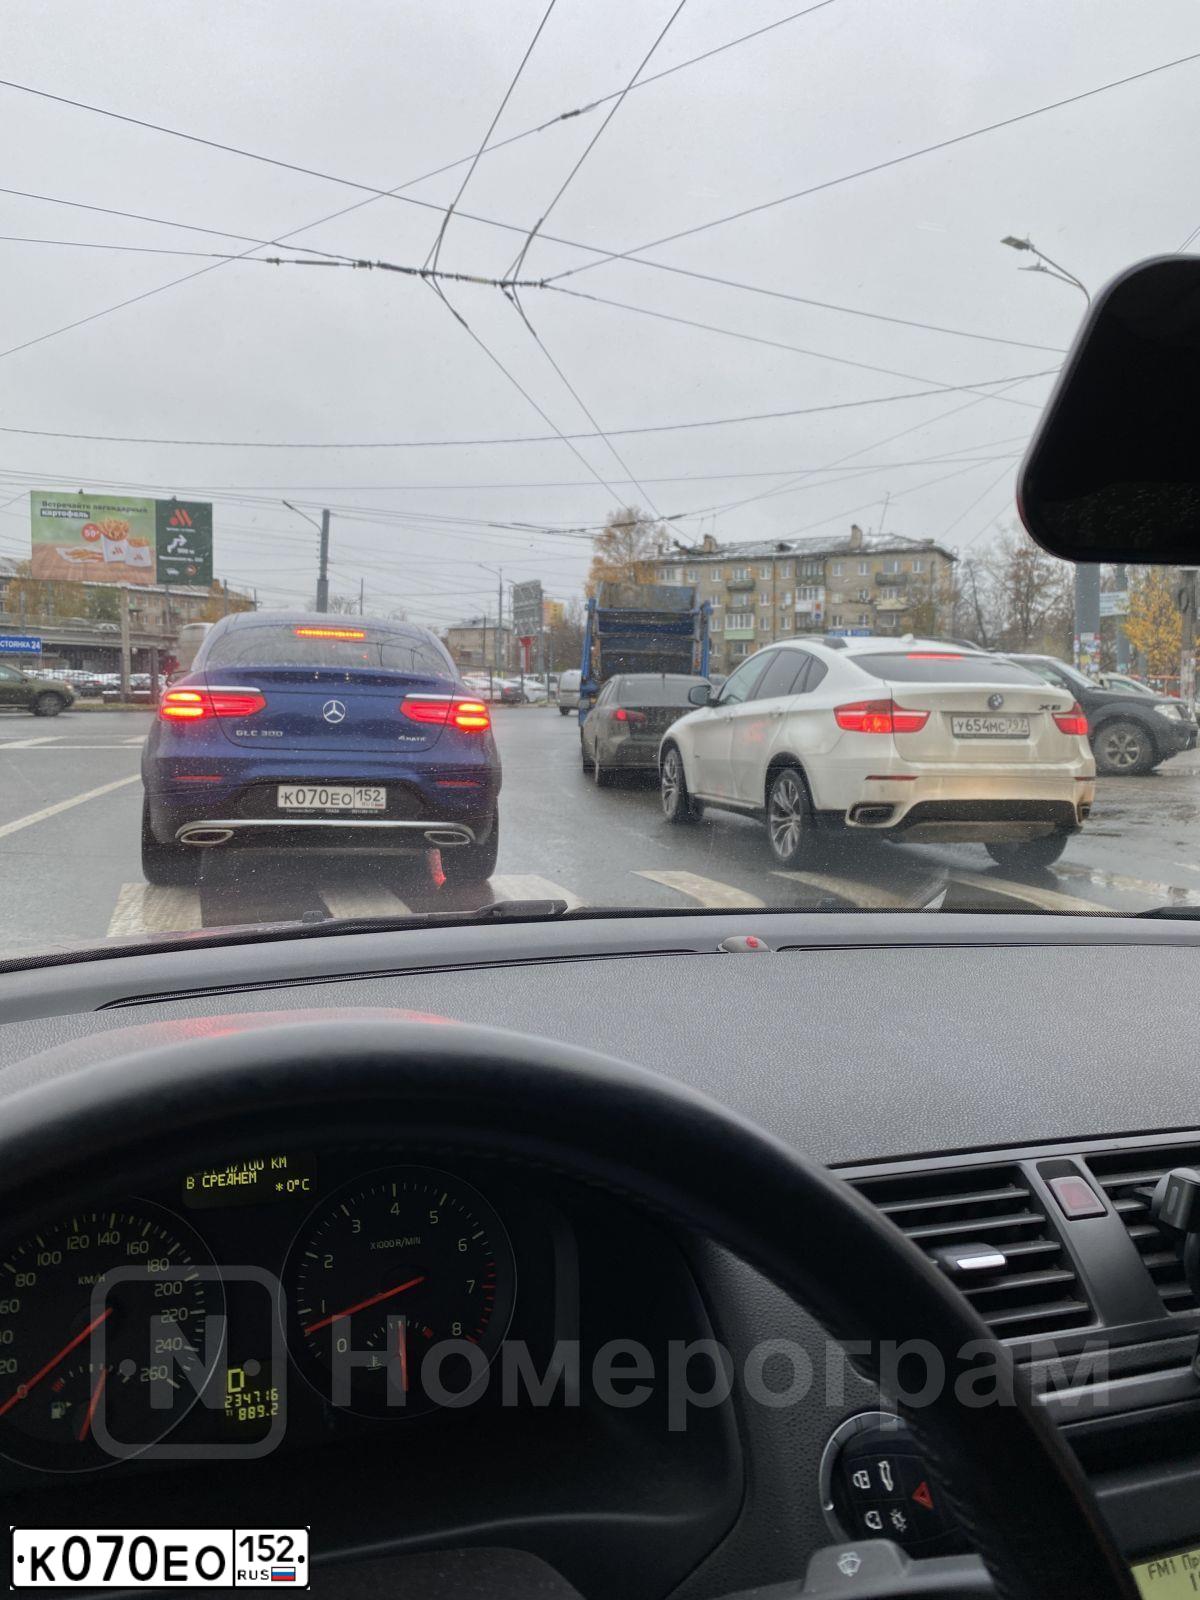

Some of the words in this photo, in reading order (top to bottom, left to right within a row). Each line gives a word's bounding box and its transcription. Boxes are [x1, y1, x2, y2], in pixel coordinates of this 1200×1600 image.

[31, 640, 41, 650] 24
[356, 789, 381, 802] 152
[186, 1176, 195, 1190] В
[202, 1171, 257, 1188] СРЕДНЕМ
[390, 1202, 400, 1216] 4
[429, 1210, 439, 1224] 5
[352, 1219, 361, 1233] 3
[67, 1235, 90, 1250] 120
[98, 1231, 120, 1246] 140
[458, 1238, 468, 1252] 6
[126, 1240, 150, 1256] 160
[37, 1251, 62, 1267] 100
[147, 1258, 170, 1273] 180
[324, 1254, 334, 1269] 2
[15, 1272, 36, 1288] 80
[78, 1274, 106, 1285] KM/H
[466, 1279, 476, 1294] 7
[154, 1281, 183, 1297] 200
[161, 1307, 188, 1323] 220
[452, 1322, 462, 1336] 8
[155, 1337, 183, 1353] 240
[336, 1338, 347, 1352] 0
[140, 1366, 168, 1382] 260
[224, 1388, 279, 1409] 234716
[239, 1402, 279, 1420] 889.2
[1147, 1559, 1176, 1580] FM1
